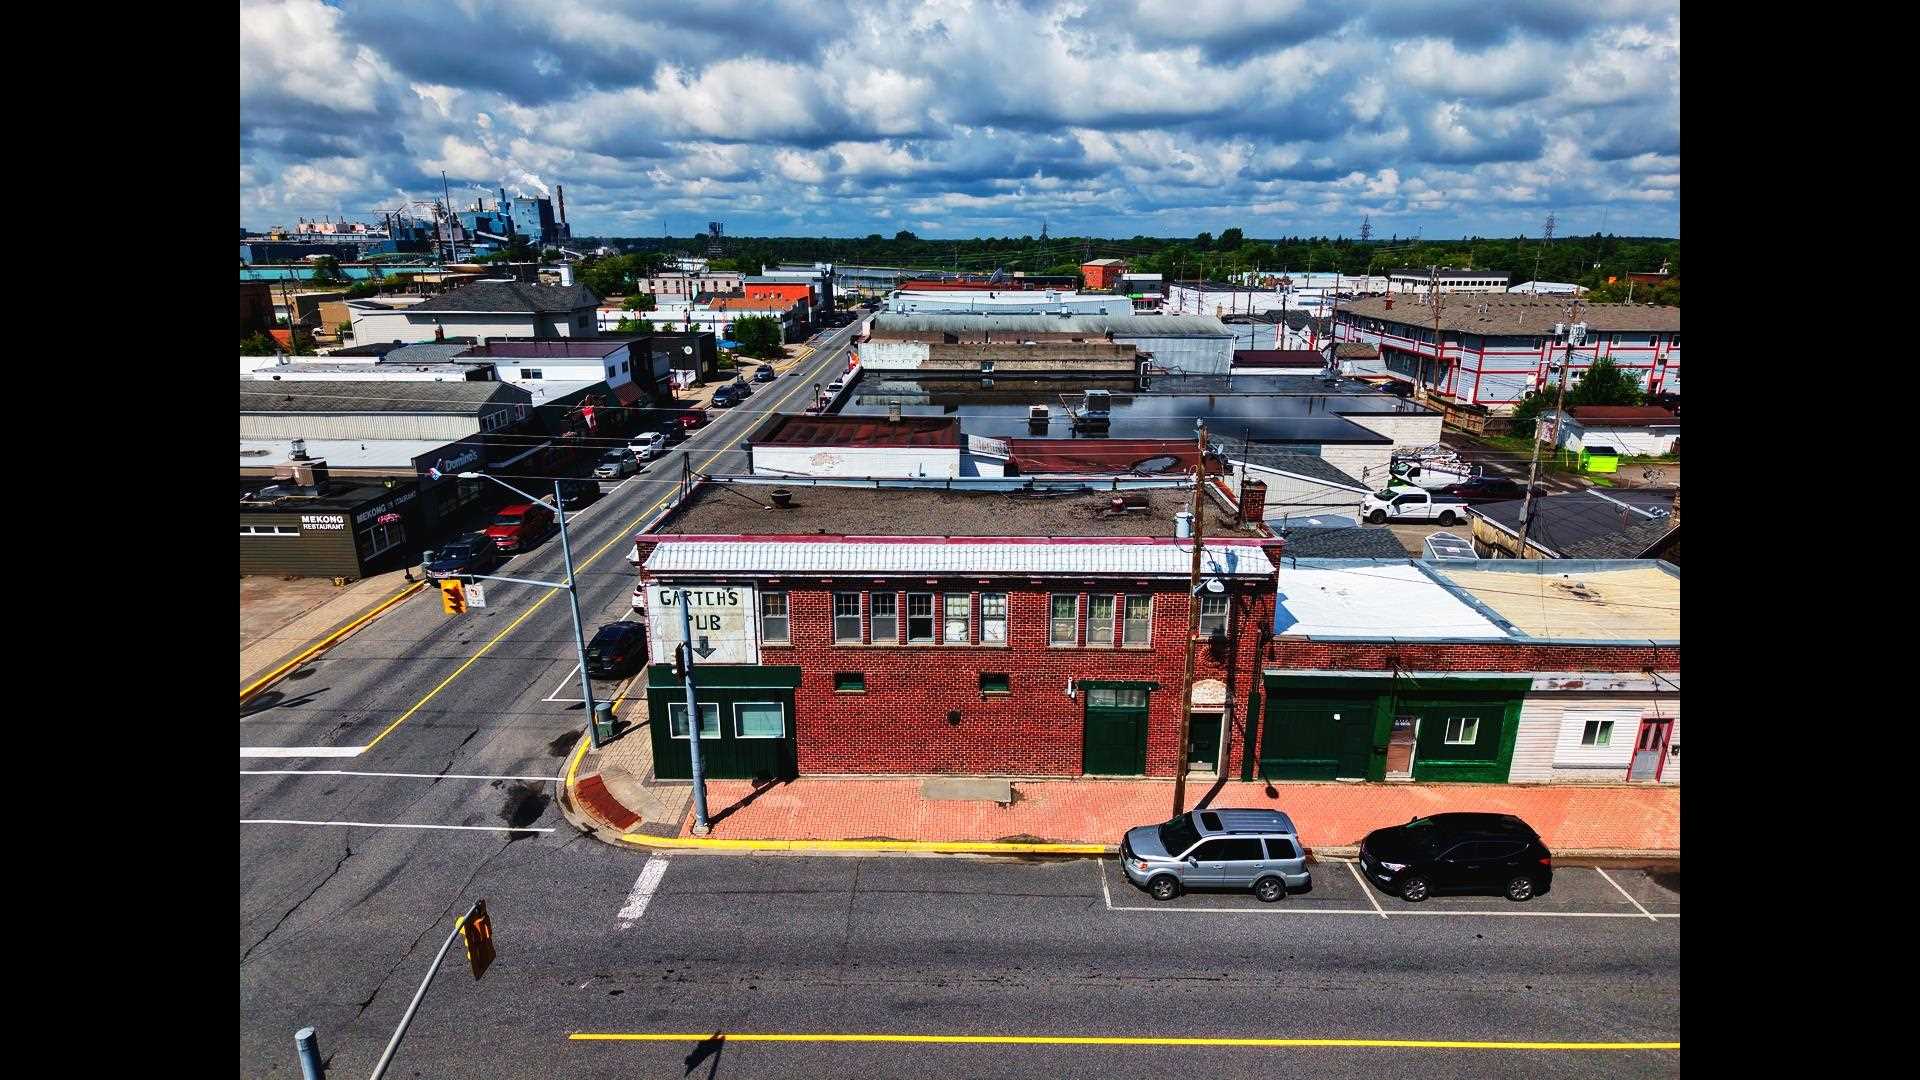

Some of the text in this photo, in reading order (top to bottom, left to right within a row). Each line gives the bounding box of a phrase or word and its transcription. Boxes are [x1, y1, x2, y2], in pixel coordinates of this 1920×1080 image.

[446, 449, 478, 471] Domino's
[301, 515, 344, 524] MEKONG
[357, 504, 386, 523] MEKONG
